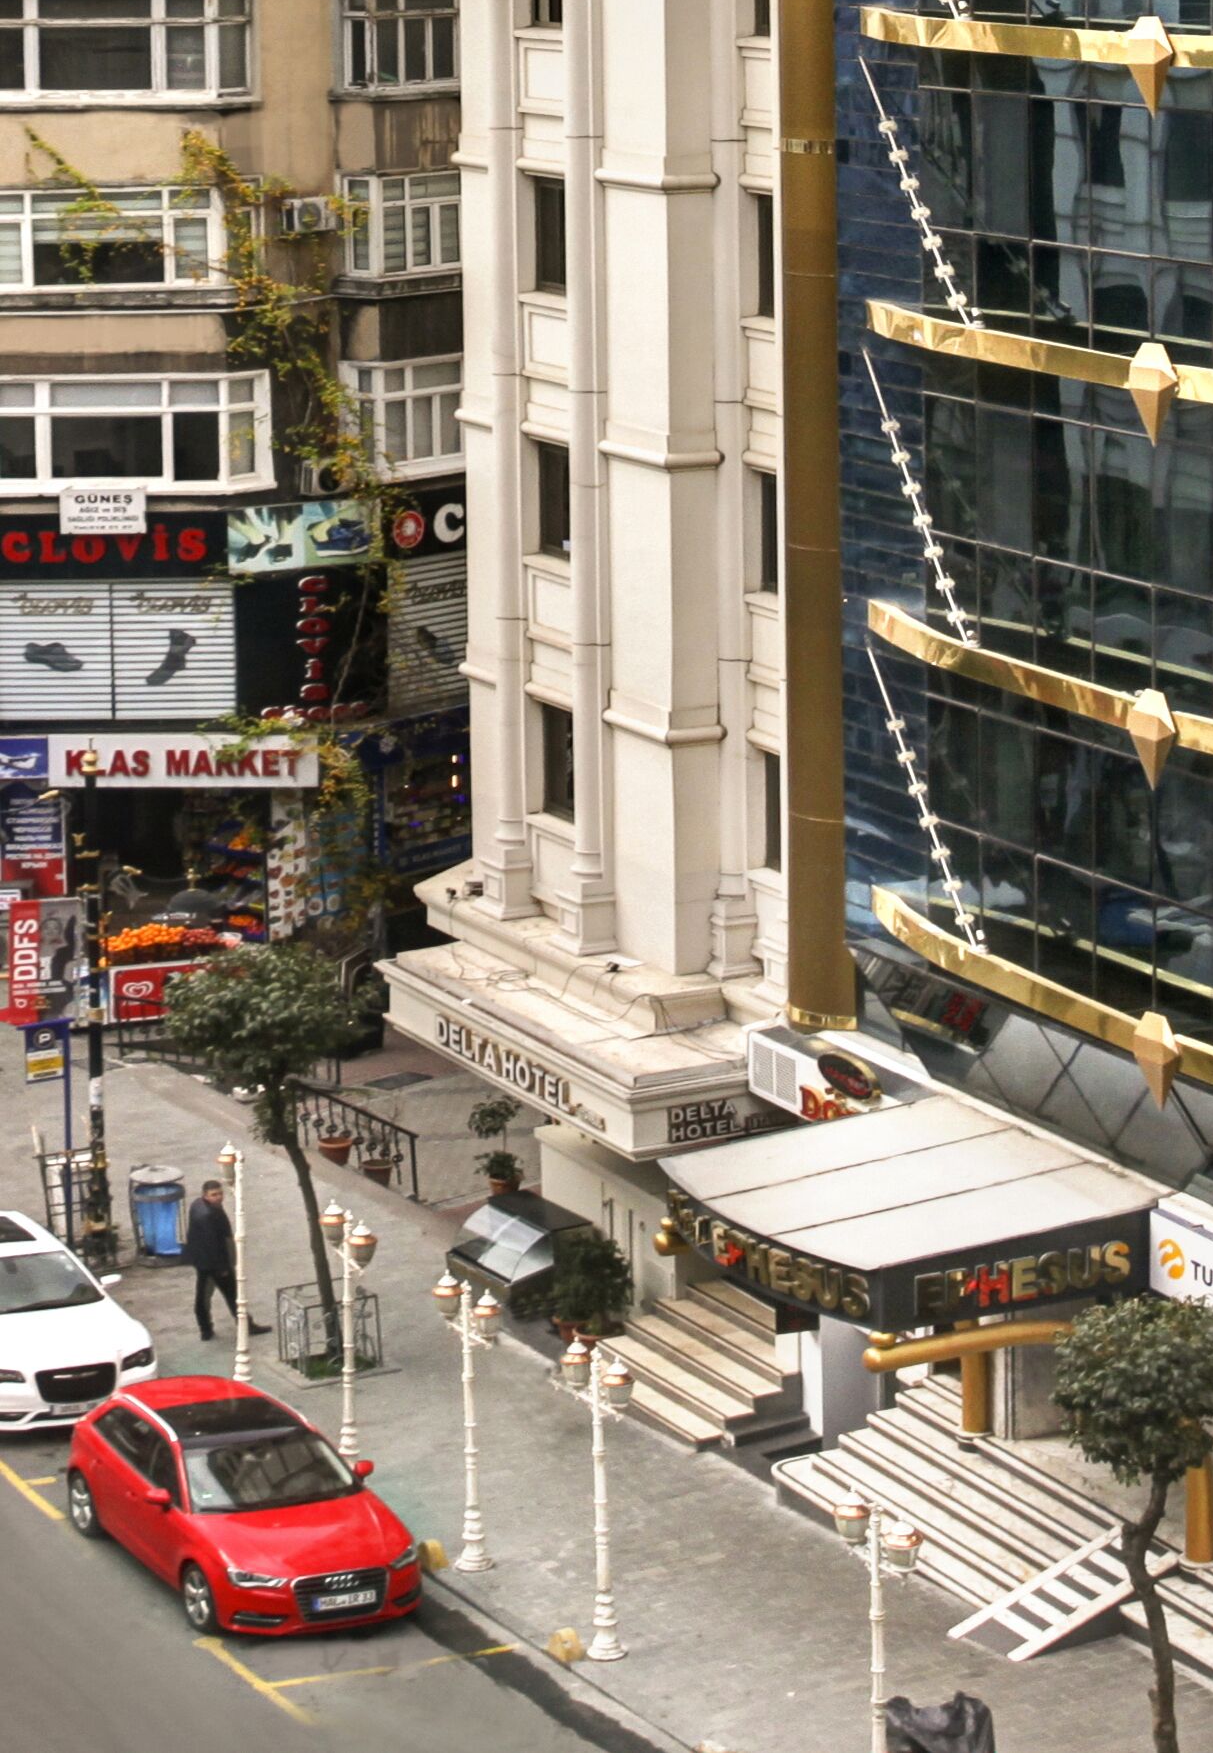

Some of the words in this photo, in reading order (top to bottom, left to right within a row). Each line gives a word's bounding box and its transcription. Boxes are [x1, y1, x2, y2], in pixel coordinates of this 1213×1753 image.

[74, 493, 133, 506] GÜNEŞ
[1, 522, 208, 564] CLOVİS
[165, 748, 302, 777] MARKET
[13, 918, 38, 982] DDFS
[435, 1014, 500, 1073] DELTA
[502, 1049, 571, 1113] HOTEL
[670, 1098, 738, 1124] DELTA
[670, 1120, 742, 1143] HOTEL
[914, 1240, 1131, 1316] EPHESUS
